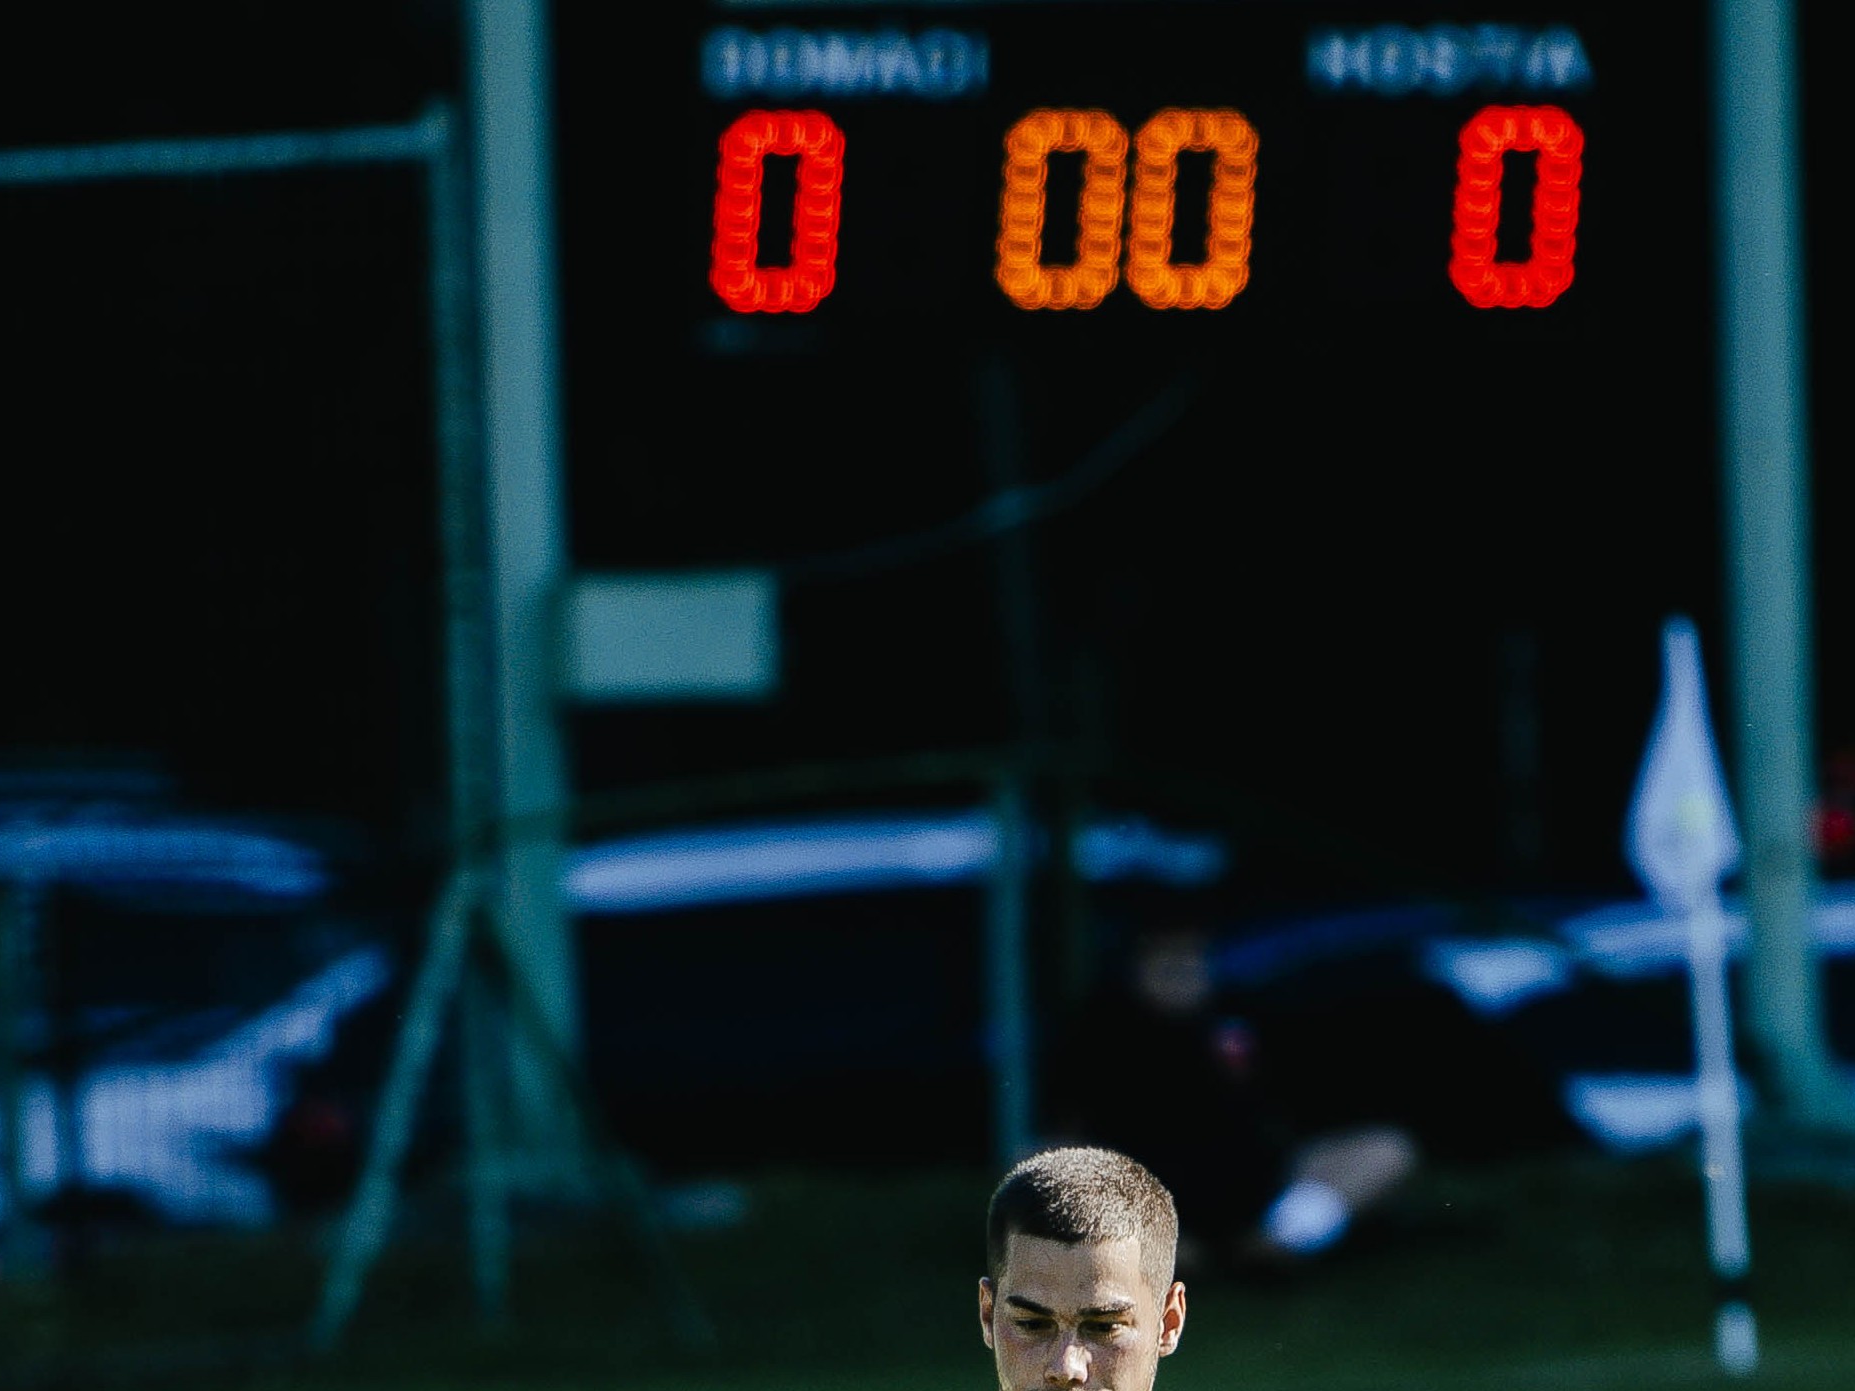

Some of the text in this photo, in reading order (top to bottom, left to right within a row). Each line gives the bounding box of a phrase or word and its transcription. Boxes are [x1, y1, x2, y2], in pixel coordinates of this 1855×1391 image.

[710, 109, 845, 313] 0
[995, 108, 1259, 310] 00
[1448, 105, 1584, 308] 0
